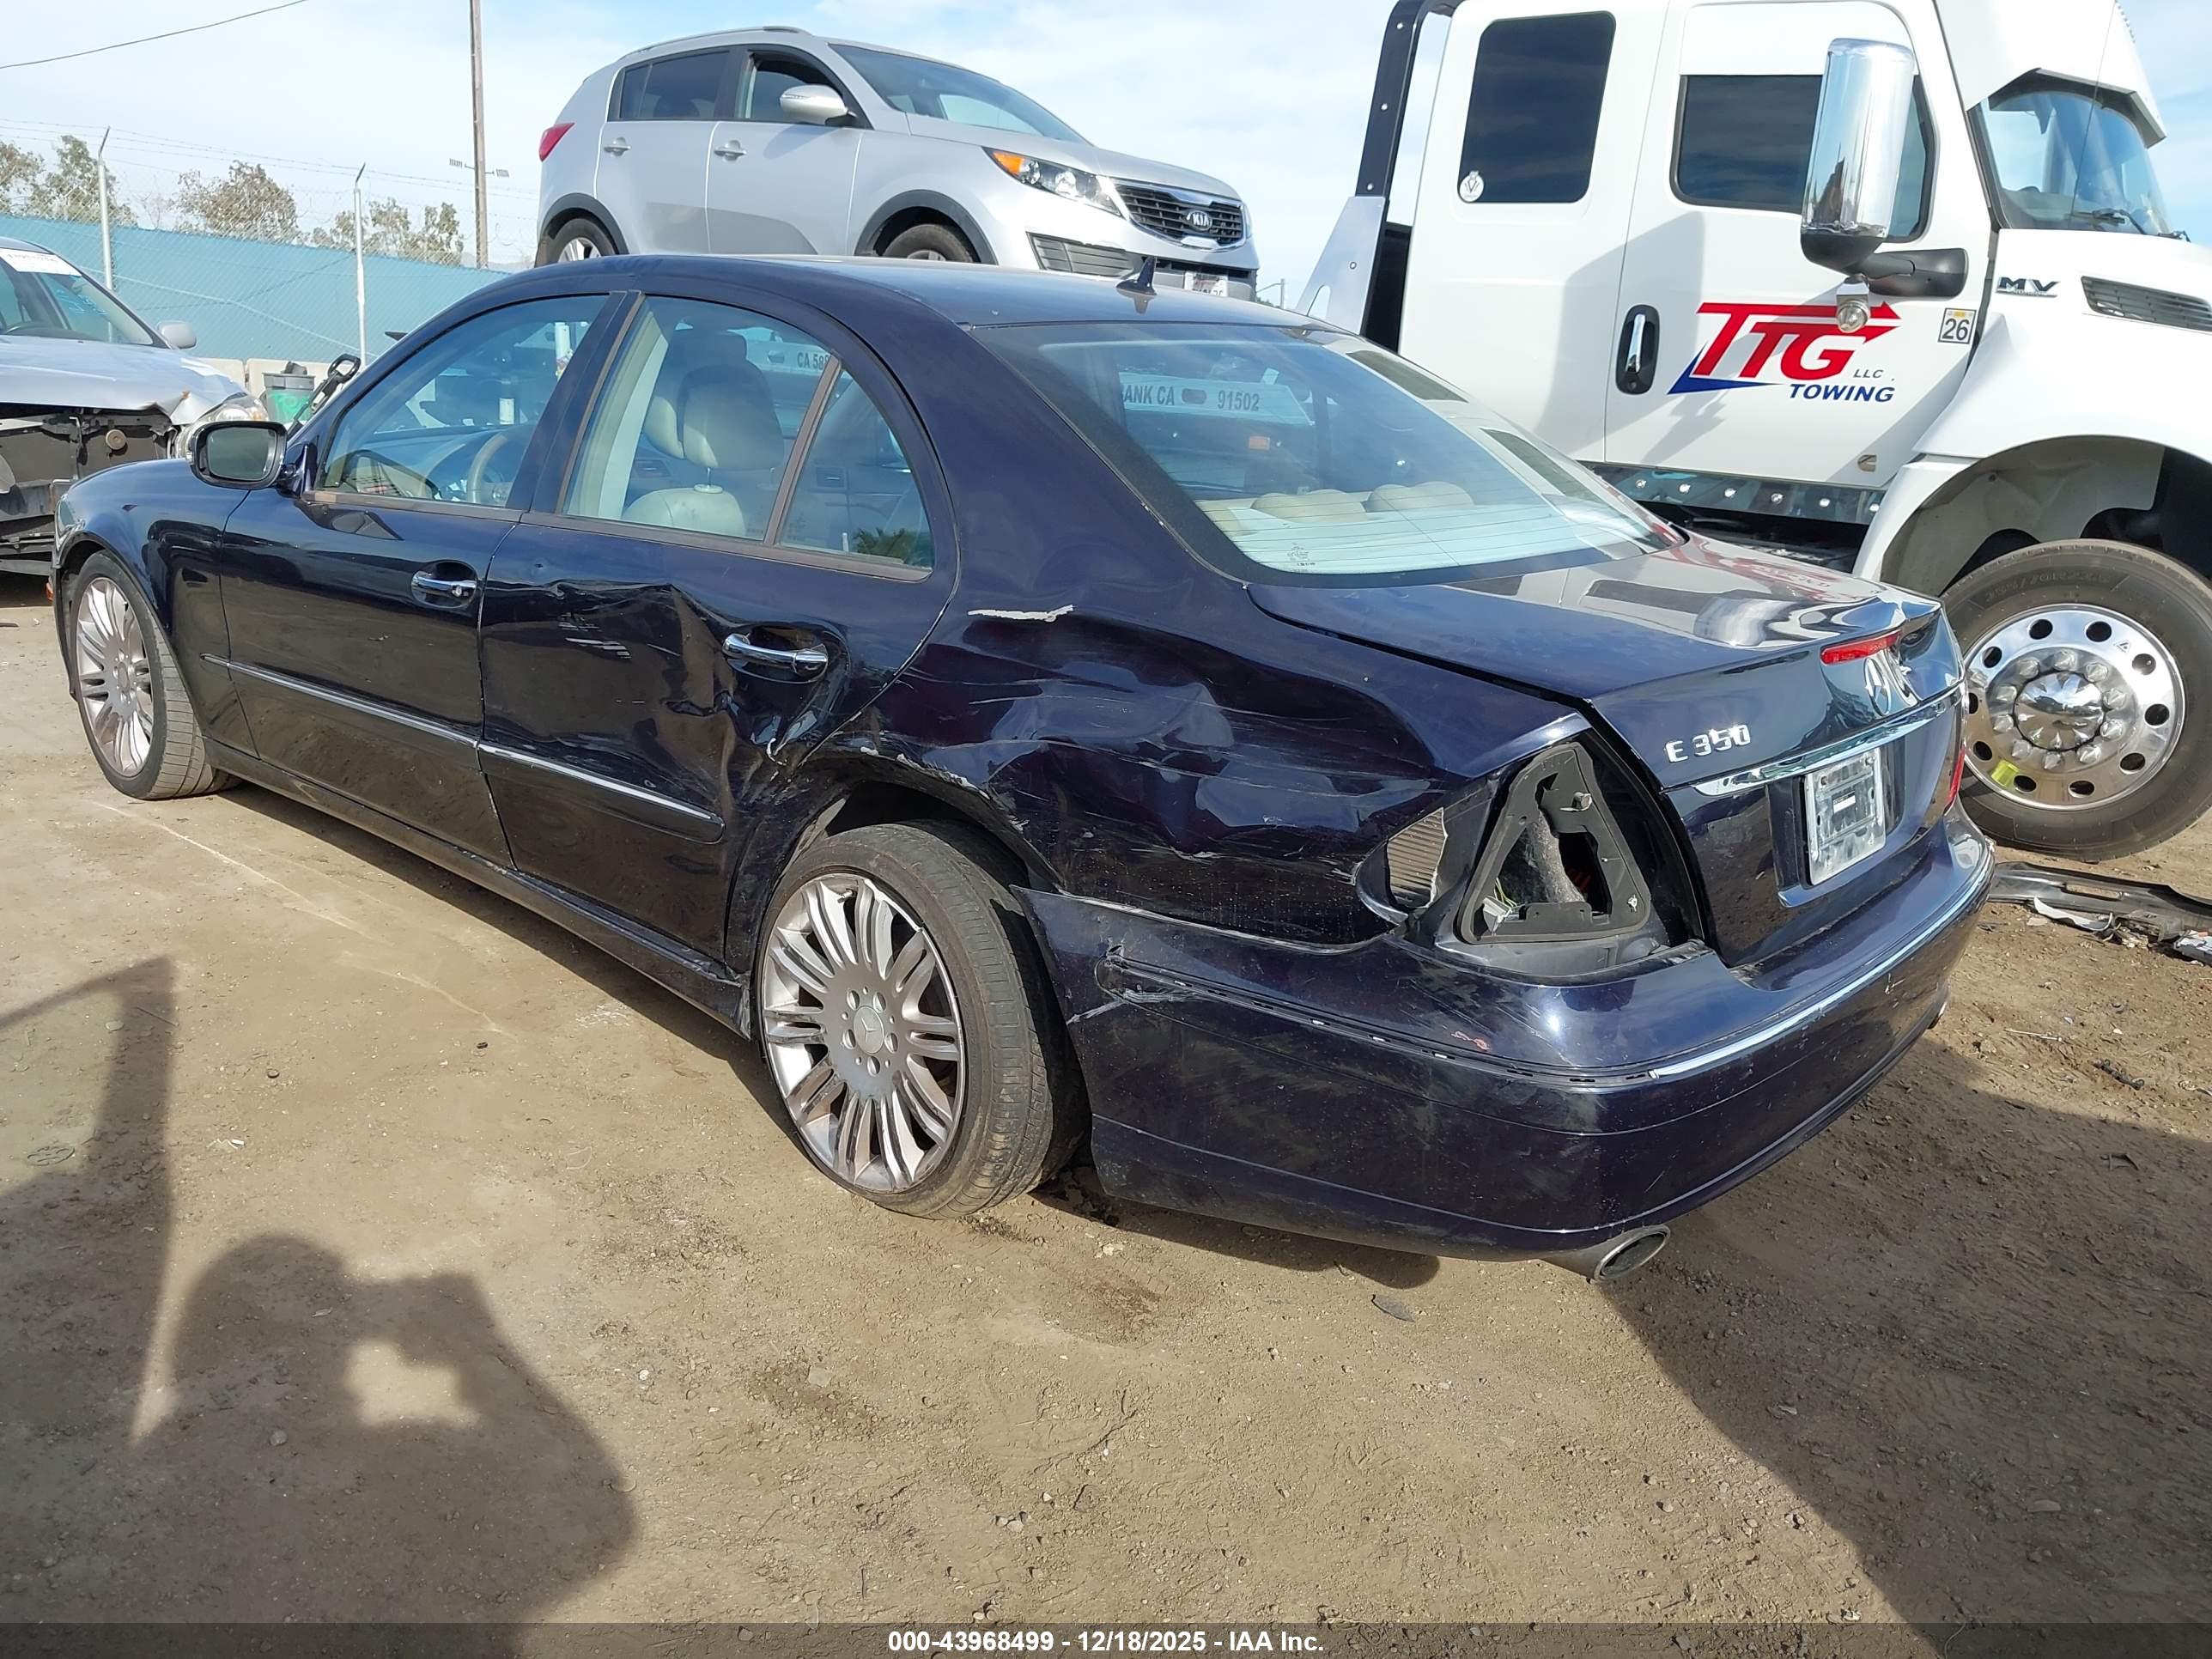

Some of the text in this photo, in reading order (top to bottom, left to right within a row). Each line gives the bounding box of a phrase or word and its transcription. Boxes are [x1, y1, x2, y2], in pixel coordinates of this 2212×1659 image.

[1192, 213, 1210, 227] KIA
[1996, 276, 2059, 293] MV
[1942, 318, 1970, 341] 26
[1692, 301, 1882, 380] TTG
[797, 352, 810, 368] CA
[1852, 368, 1884, 379] LLC
[1121, 385, 1260, 411] ANK CA 91502
[1790, 383, 1895, 402] TOWING
[1664, 724, 1751, 763] E 350
